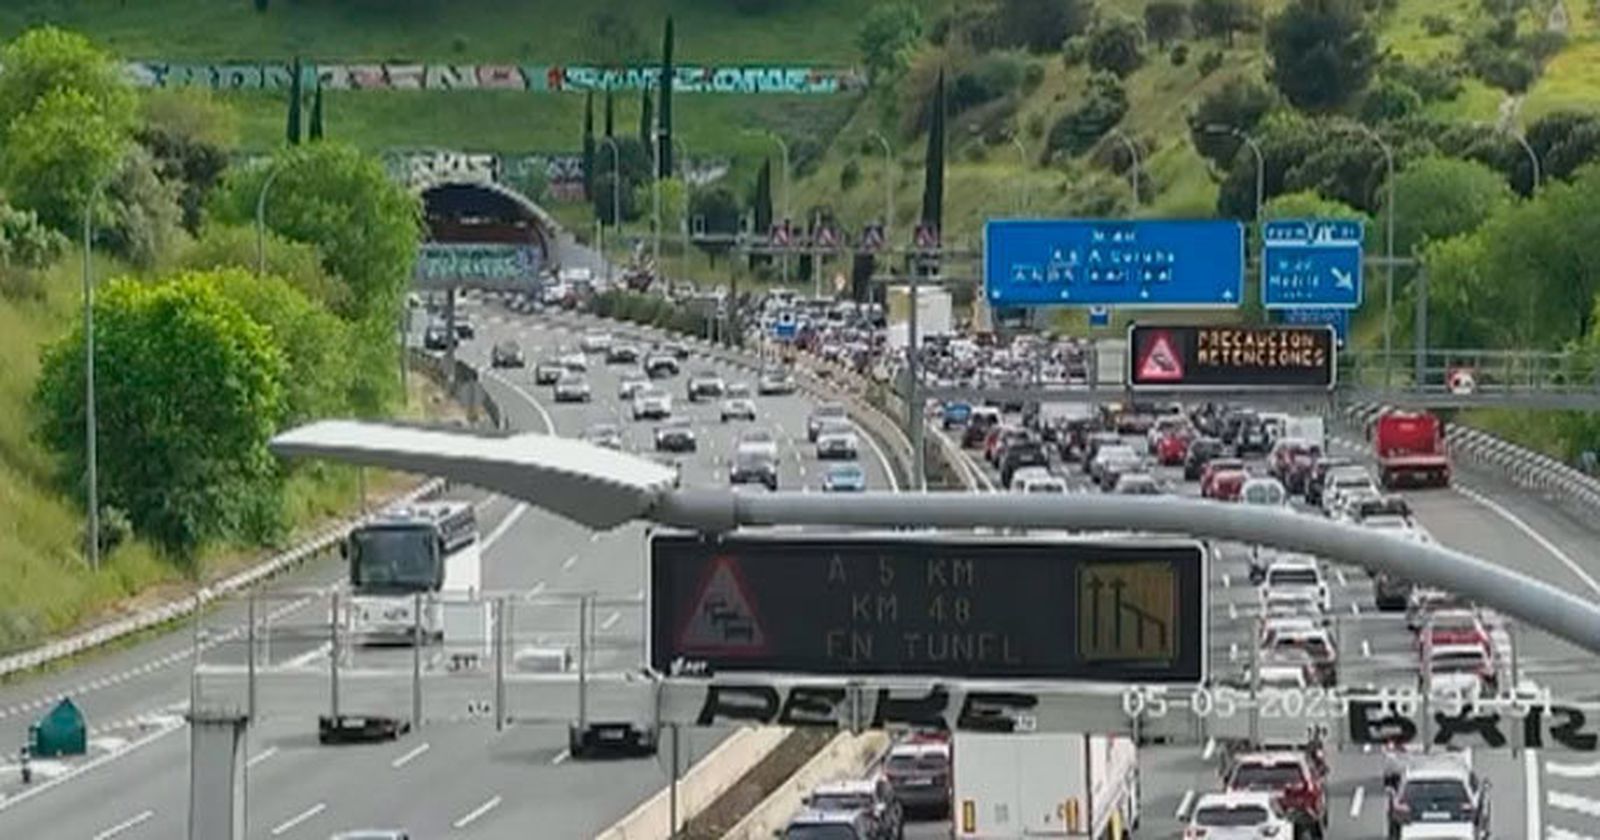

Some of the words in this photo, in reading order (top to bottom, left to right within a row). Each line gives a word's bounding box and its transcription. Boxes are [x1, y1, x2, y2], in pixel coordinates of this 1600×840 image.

[827, 552, 846, 582] A
[879, 556, 895, 586] 5
[927, 558, 974, 586] KM
[852, 594, 898, 621] KM
[929, 598, 971, 624] 48
